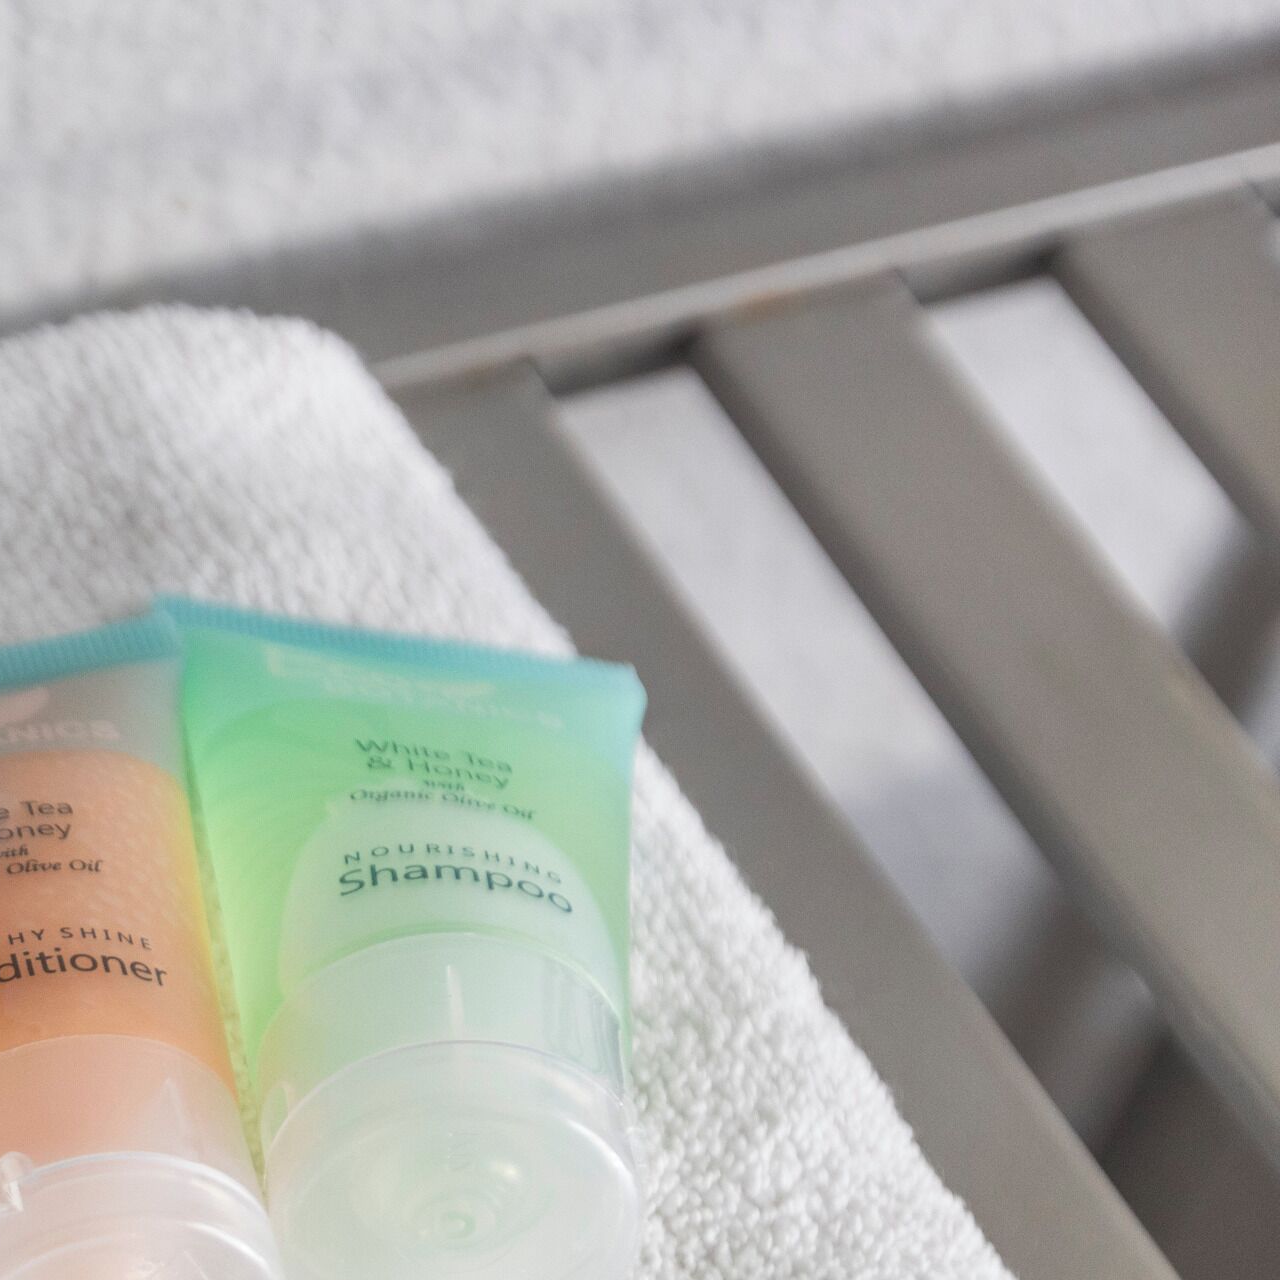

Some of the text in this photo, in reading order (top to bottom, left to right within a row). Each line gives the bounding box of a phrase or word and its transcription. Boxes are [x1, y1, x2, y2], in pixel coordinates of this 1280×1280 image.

[354, 738, 513, 774] White Tea
[407, 758, 510, 791] Honey
[19, 800, 74, 816] Tea
[6, 858, 62, 875] Olive
[68, 859, 104, 873] Oil
[344, 843, 562, 884] NOURISHING
[339, 863, 573, 913] Shampoo
[60, 926, 153, 951] SHINE
